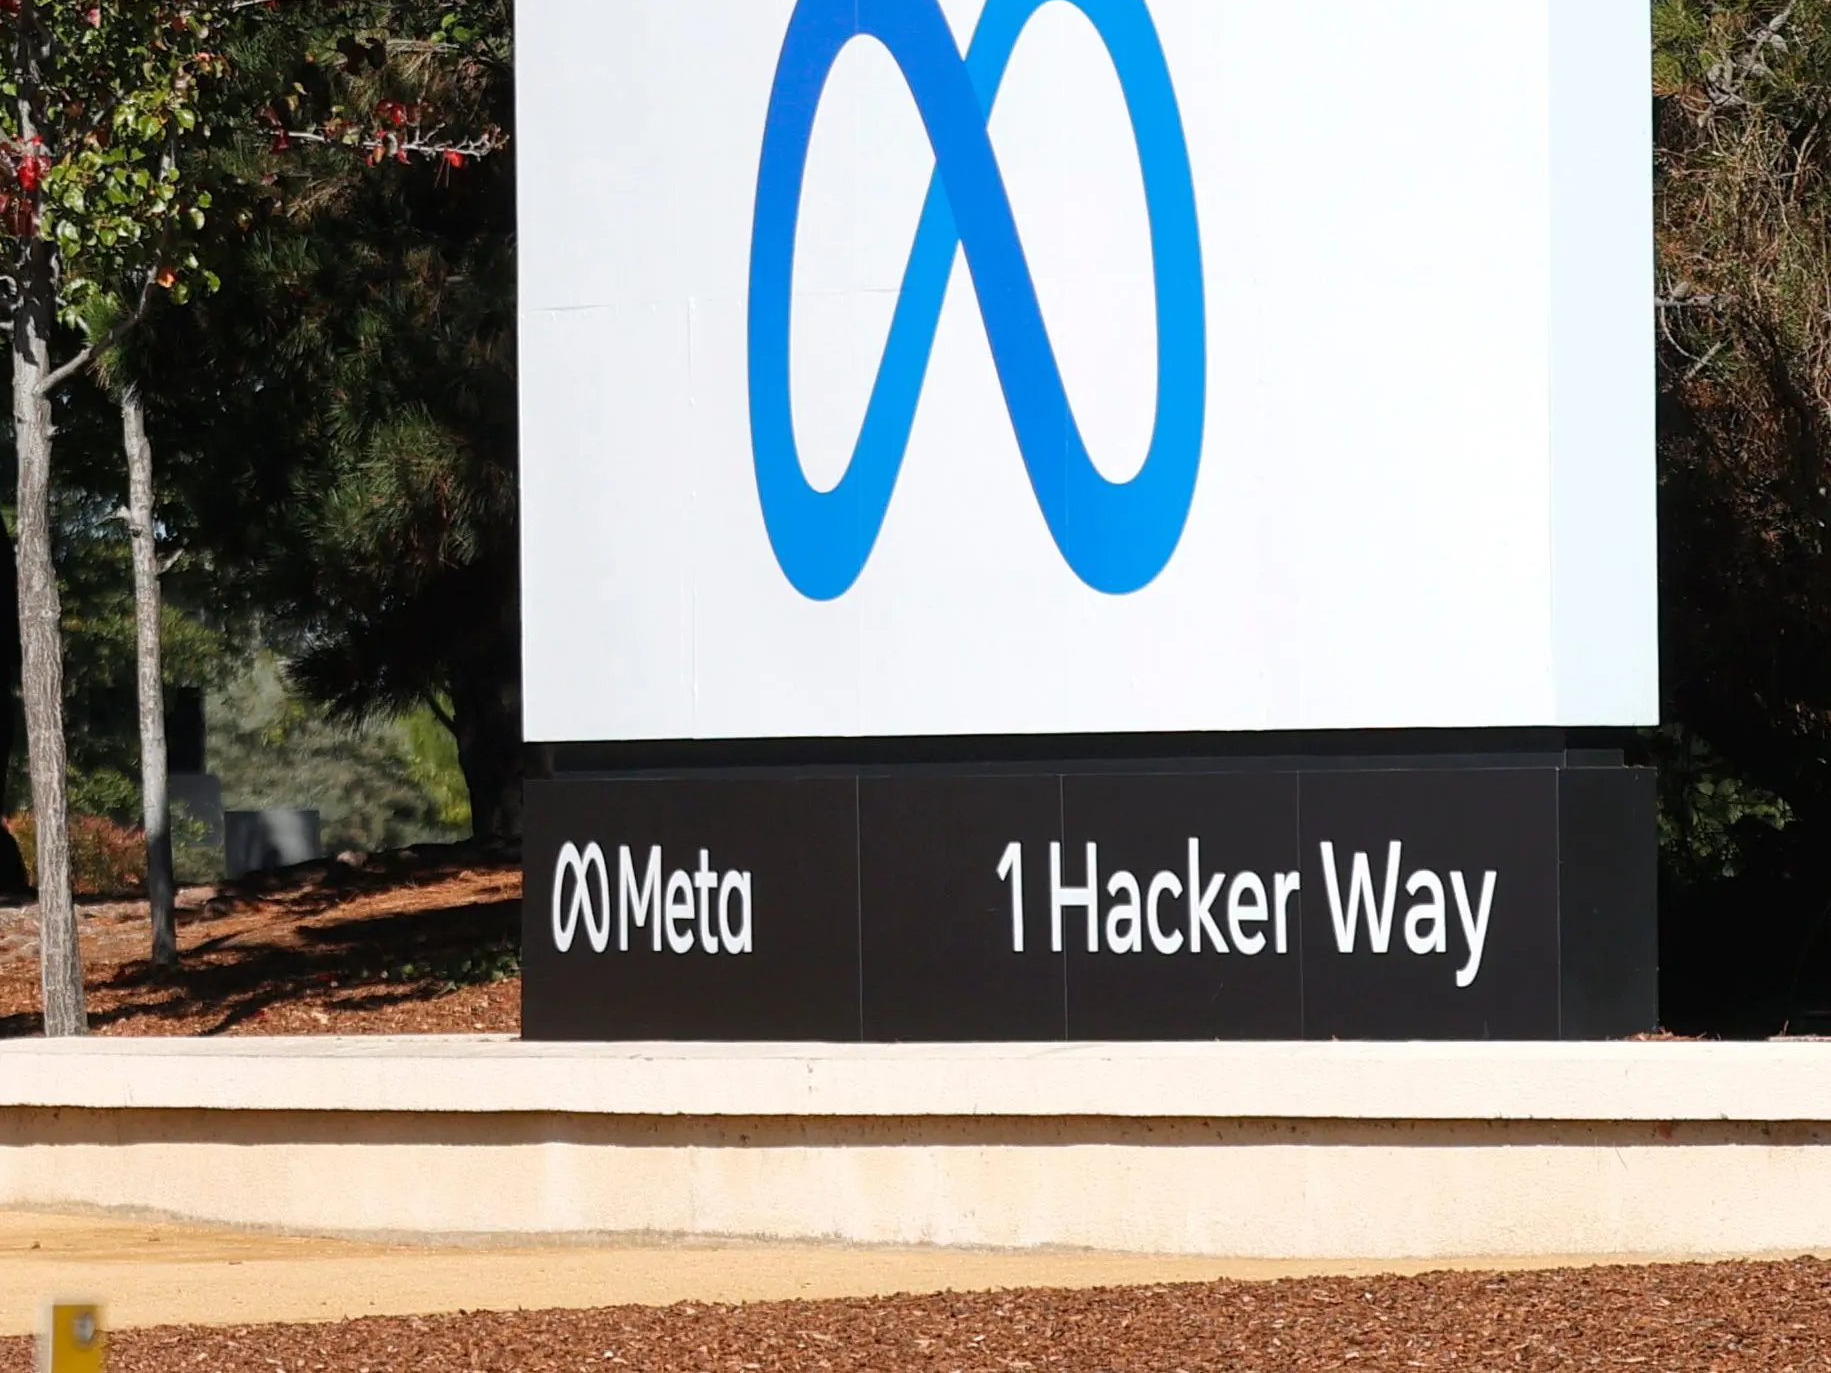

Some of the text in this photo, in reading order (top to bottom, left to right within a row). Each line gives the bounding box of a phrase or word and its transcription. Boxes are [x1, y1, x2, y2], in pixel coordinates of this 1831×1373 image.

[619, 843, 754, 955] Meta
[996, 837, 1498, 988] 1 Hacker Way
